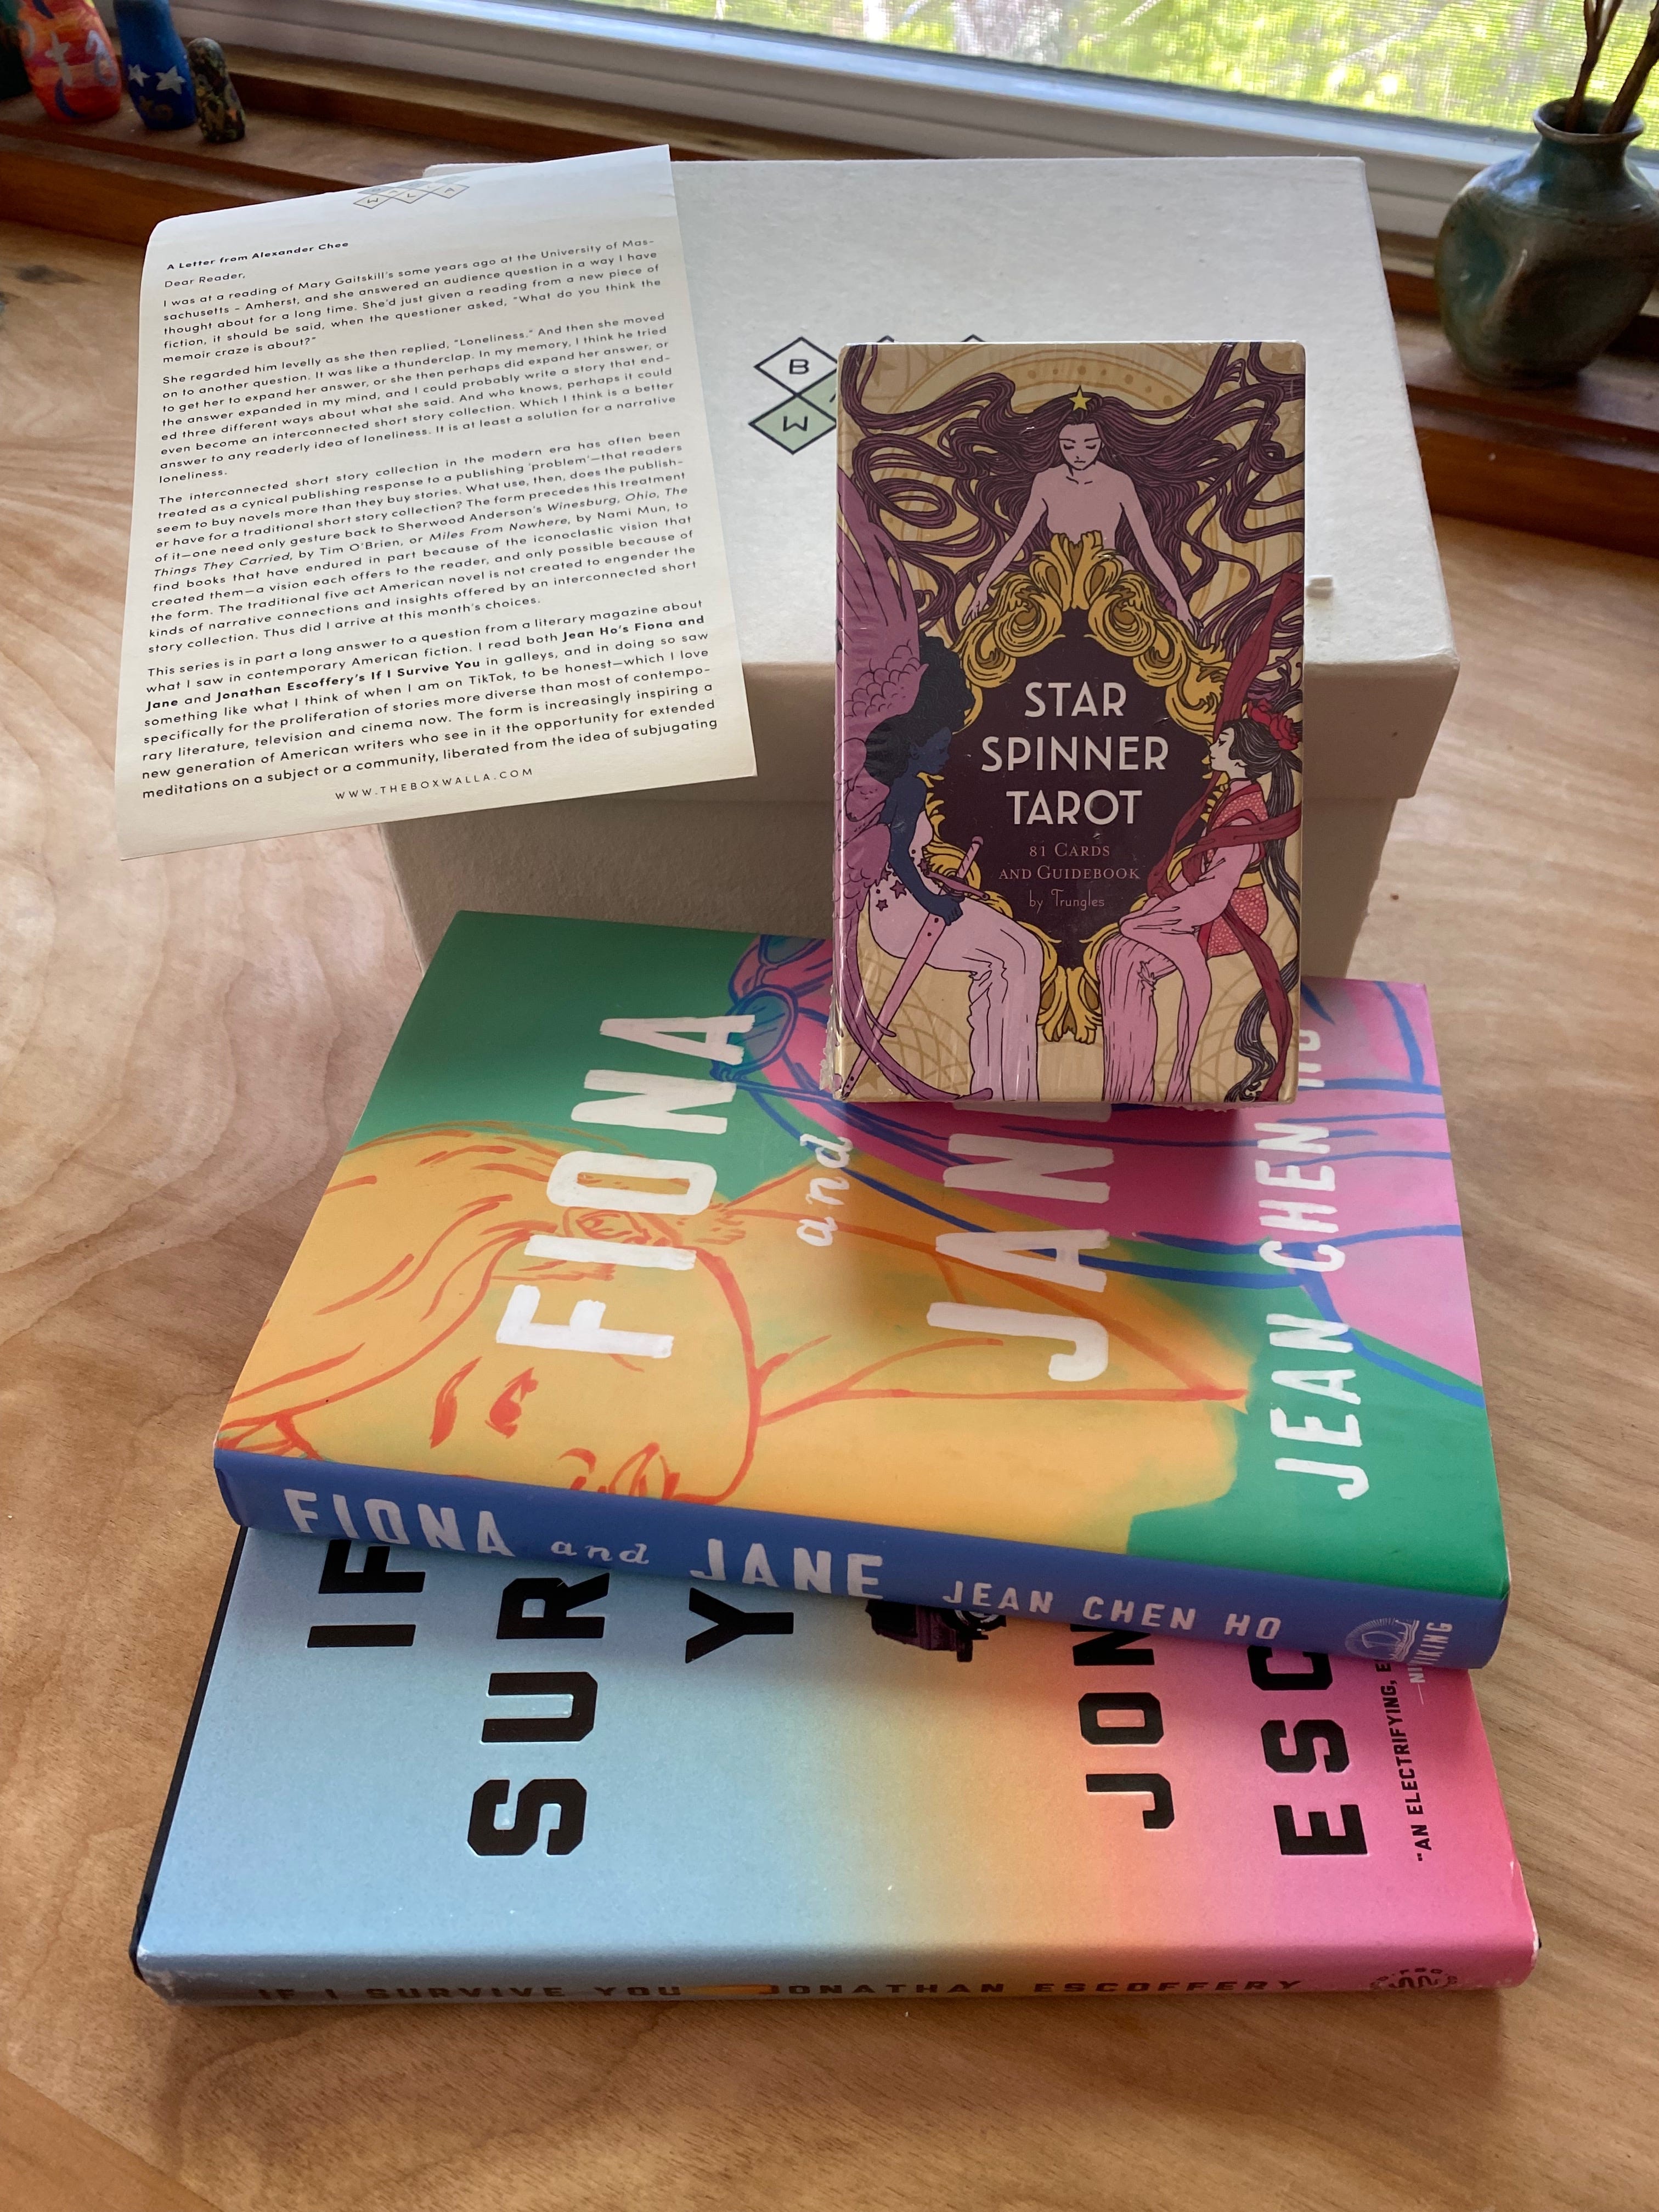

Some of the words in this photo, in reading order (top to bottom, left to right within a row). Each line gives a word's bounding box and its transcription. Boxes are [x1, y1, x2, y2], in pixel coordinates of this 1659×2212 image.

[165, 279, 195, 288] Dear
[199, 272, 245, 284] Reader,
[171, 298, 195, 308] was
[199, 295, 212, 303] at
[229, 287, 277, 299] reading
[280, 283, 294, 294] of
[298, 281, 330, 290] Mary
[398, 268, 430, 277] some
[435, 263, 468, 274] years
[473, 259, 496, 268] ago
[501, 256, 512, 264] at
[517, 253, 536, 262] the
[541, 245, 601, 258] University
[606, 241, 617, 250] of
[623, 240, 654, 248] Mas-
[179, 259, 216, 269] Letter
[252, 247, 314, 259] Alexander
[161, 431, 177, 441] ed
[182, 428, 216, 438] three
[221, 419, 278, 433] different
[282, 416, 313, 425] ways
[319, 409, 356, 420] about
[361, 404, 392, 415] what
[398, 402, 419, 410] she
[424, 396, 454, 407] said.
[459, 392, 483, 402] And
[489, 389, 515, 398] who
[520, 384, 562, 394] knows,
[568, 376, 620, 390] perhaps
[638, 368, 672, 379] could
[159, 495, 182, 505] The
[190, 480, 288, 501] interconnected
[296, 476, 329, 487] short
[336, 472, 368, 482] story
[376, 463, 438, 477] collection
[445, 459, 457, 467] in
[464, 456, 484, 465] the
[492, 449, 542, 461] modern
[549, 445, 571, 454] era
[578, 442, 601, 450] has
[608, 437, 641, 446] often
[648, 432, 680, 441] been
[153, 581, 179, 592] find
[187, 576, 225, 588] books
[233, 571, 260, 582] that
[267, 568, 299, 578] have
[306, 557, 362, 572] endured
[369, 556, 380, 564] in
[387, 551, 416, 564] part
[423, 545, 479, 557] because
[486, 539, 499, 549] of
[506, 537, 527, 546] the
[534, 526, 613, 543] iconoclastic
[620, 521, 658, 532] vision
[665, 516, 691, 526] that
[143, 751, 172, 761] rary
[178, 742, 249, 757] literature,
[255, 731, 322, 747] television
[329, 725, 356, 737] and
[361, 720, 413, 733] cinema
[419, 716, 452, 726] now.
[457, 710, 483, 721] The
[489, 707, 523, 717] form
[528, 703, 539, 712] is
[545, 692, 631, 710] increasingly
[636, 685, 698, 700] inspiring
[144, 725, 224, 746] specifically
[228, 723, 249, 733] for
[253, 719, 275, 730] the
[280, 708, 369, 729] proliferation
[374, 703, 388, 714] of
[393, 699, 439, 712] stories
[444, 695, 480, 706] more
[485, 688, 536, 700] diverse
[540, 683, 572, 693] than
[577, 677, 611, 689] most
[616, 674, 629, 684] of
[634, 668, 710, 682] contempo-
[1024, 681, 1127, 718] STAR
[142, 769, 171, 780] new
[176, 758, 255, 778] generation
[261, 752, 275, 764] of
[280, 746, 348, 761] American
[354, 740, 404, 752] writers
[409, 733, 439, 745] who
[443, 731, 468, 741] see
[474, 727, 486, 737] in
[492, 725, 501, 735] it
[506, 723, 529, 733] the
[534, 712, 618, 732] opportunity
[623, 709, 644, 719] for
[650, 699, 715, 716] extended
[143, 781, 228, 799] meditations
[232, 777, 249, 787] on
[267, 766, 319, 782] subject
[323, 766, 338, 775] or
[356, 753, 438, 770] community,
[443, 742, 509, 760] liberated
[514, 741, 548, 751] from
[551, 736, 574, 746] the
[579, 732, 610, 743] idea
[615, 727, 629, 738] of
[633, 719, 717, 737] subjugating
[981, 736, 1169, 772] SPINNER
[335, 768, 532, 800] WWW.THEBOXWALLA.COM
[1006, 789, 1142, 825] TAROT
[998, 868, 1032, 879] AND
[1029, 845, 1046, 857] 81
[1029, 889, 1043, 914] by
[1051, 889, 1105, 911] Trungles
[496, 1014, 756, 1359] FIONA
[797, 1133, 855, 1248] and
[927, 1102, 1114, 1382] JAN
[1254, 1122, 1346, 1272] CHEN
[1266, 1313, 1369, 1500] JEAN
[284, 1488, 516, 1557] FIONA
[550, 1540, 650, 1565] and
[689, 1538, 884, 1599] JANE
[943, 1581, 1054, 1614] JEAN
[1082, 1595, 1197, 1630] CHEN
[1223, 1614, 1282, 1640] HO
[307, 1539, 426, 1648] IF
[1408, 1622, 1453, 1666] VIKING
[467, 1572, 610, 1856] SUR
[1380, 1679, 1425, 1815] ELECTRIFYING,
[258, 1989, 295, 2000] IF
[366, 1987, 565, 1999] SURVIVE
[593, 1986, 681, 1997] YOU
[759, 1983, 1004, 1994] JONATHAN
[1034, 1980, 1302, 1993] ESCOFFERY
